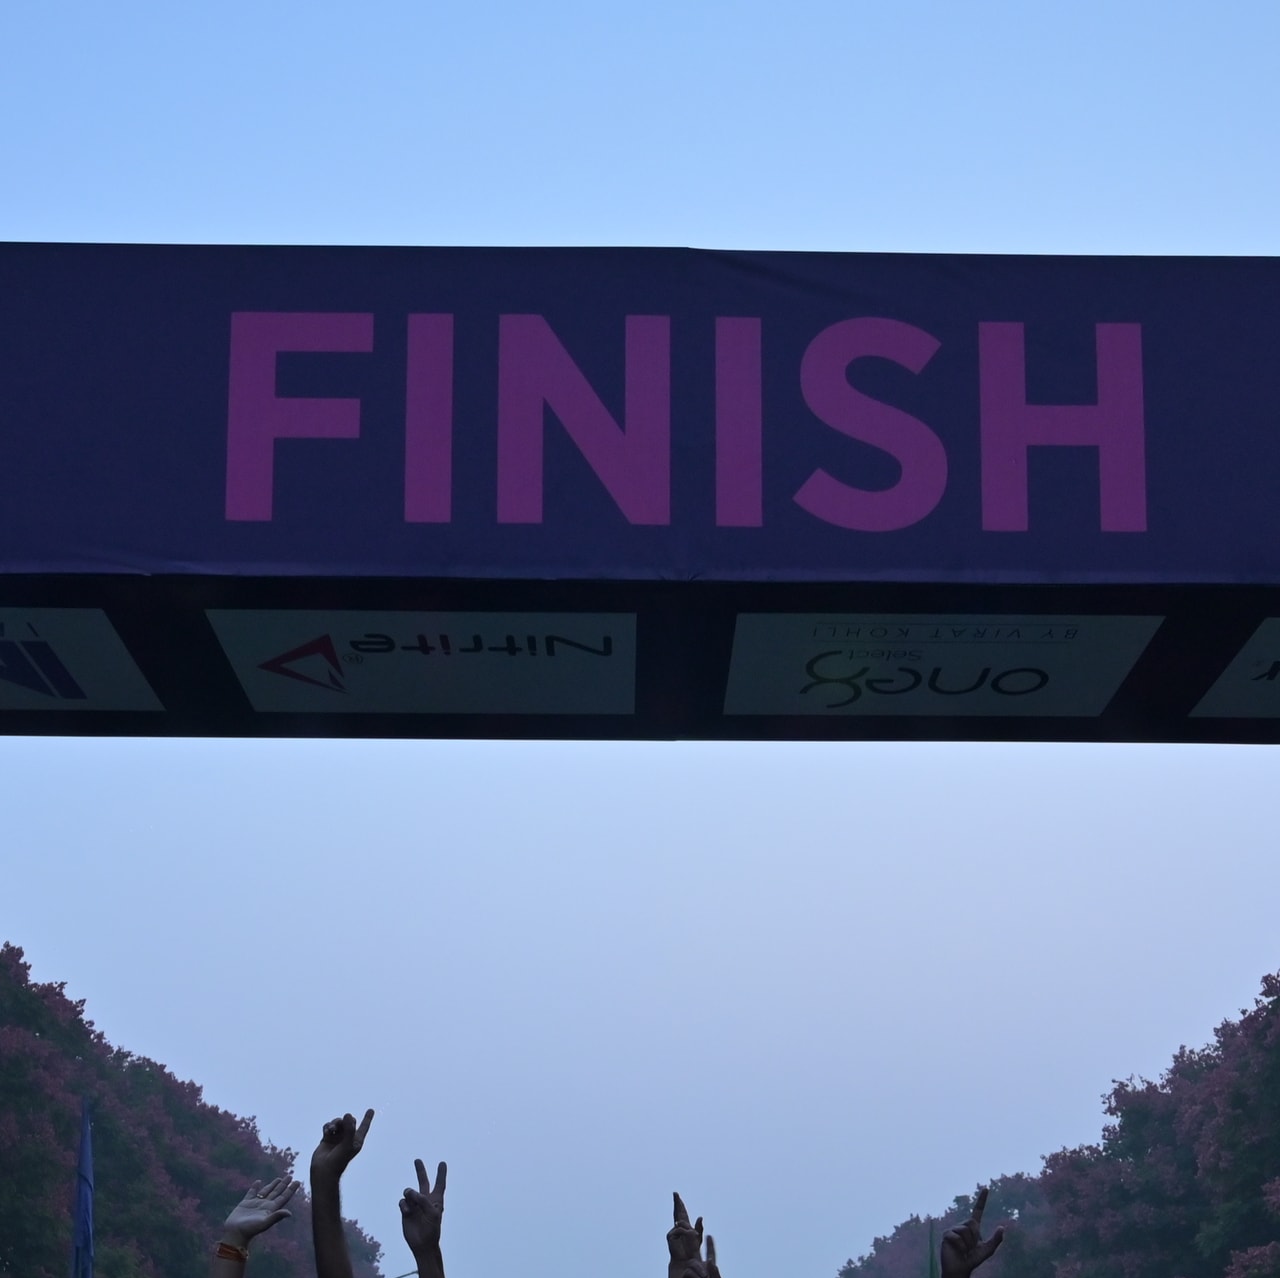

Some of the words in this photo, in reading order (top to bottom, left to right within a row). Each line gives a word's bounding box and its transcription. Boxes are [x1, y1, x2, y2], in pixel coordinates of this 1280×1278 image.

[225, 311, 1147, 533] FINISH
[812, 627, 910, 638] KOHLI
[931, 628, 1020, 639] VIRAT
[1042, 629, 1078, 639] BY
[350, 633, 613, 658] Nitrite
[850, 649, 921, 660] Select
